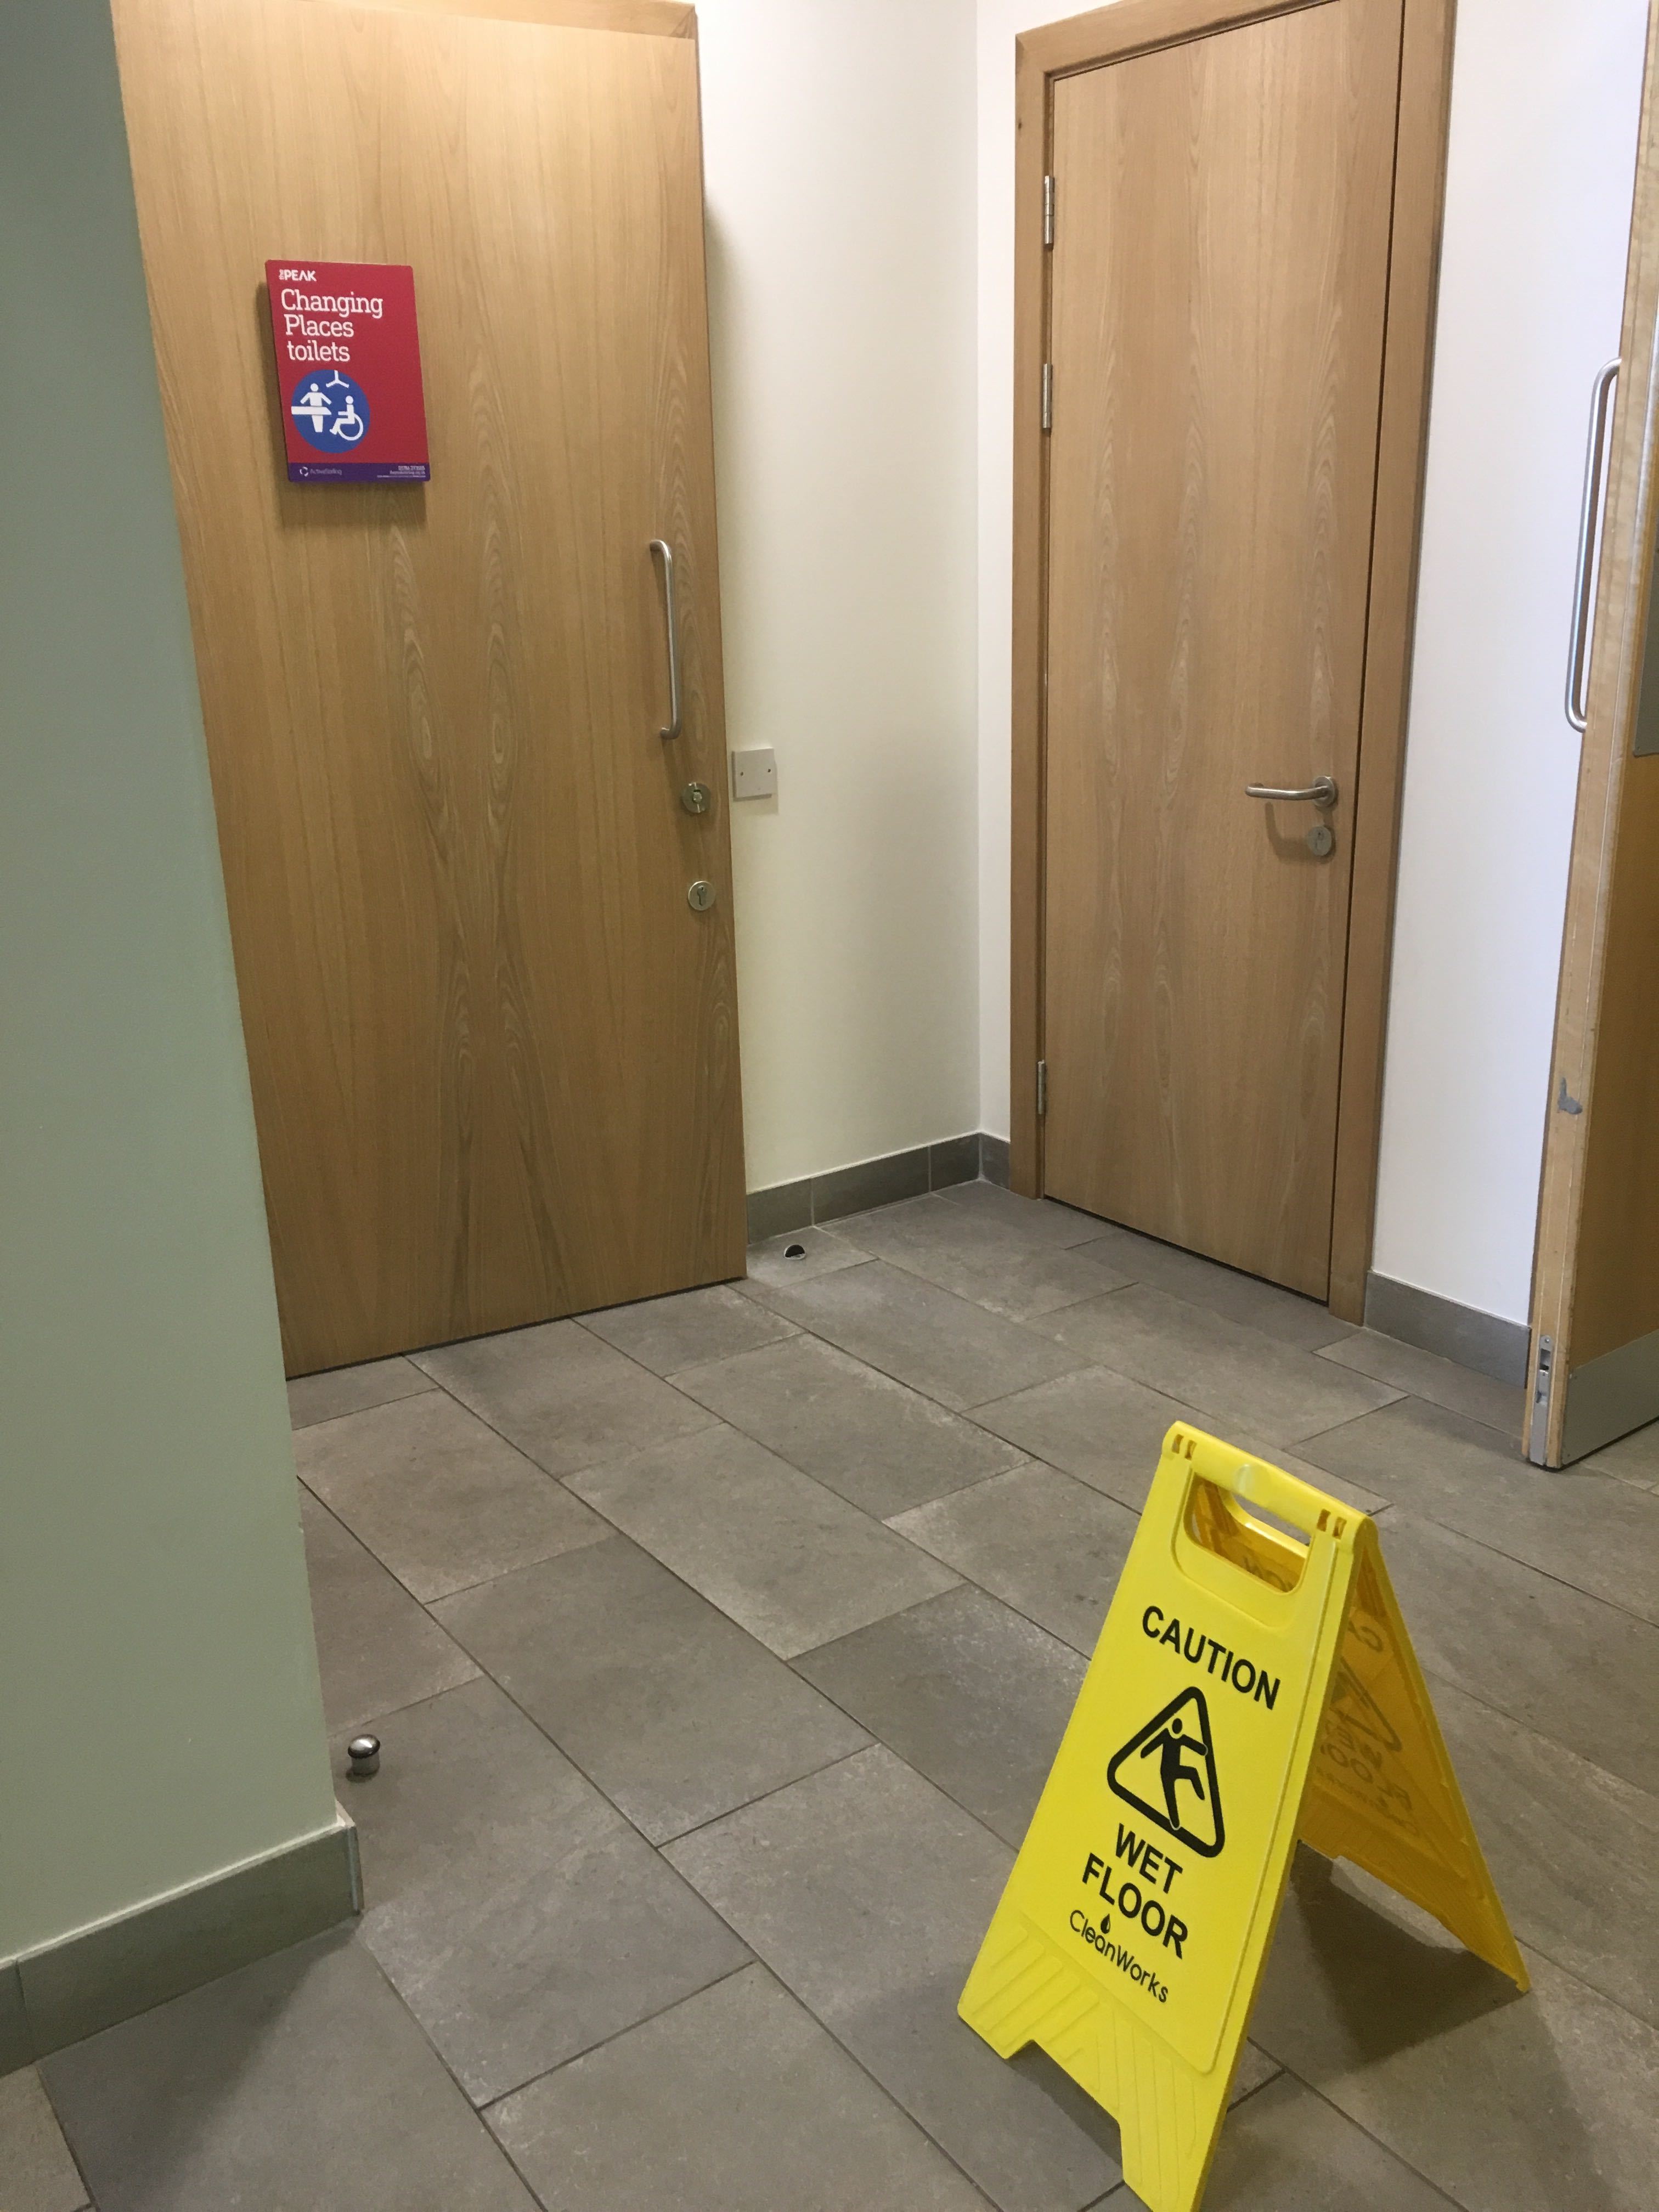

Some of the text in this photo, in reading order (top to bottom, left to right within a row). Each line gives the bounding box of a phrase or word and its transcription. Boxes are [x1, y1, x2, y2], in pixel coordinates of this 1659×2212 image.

[281, 288, 383, 319] Changing
[284, 313, 354, 337] Places
[287, 340, 351, 362] toilets
[1142, 1605, 1281, 1711] CAUTION
[1115, 1822, 1183, 1894] WET
[1082, 1852, 1188, 1960] FLOOR
[1070, 1909, 1169, 2003] CleanWorks
